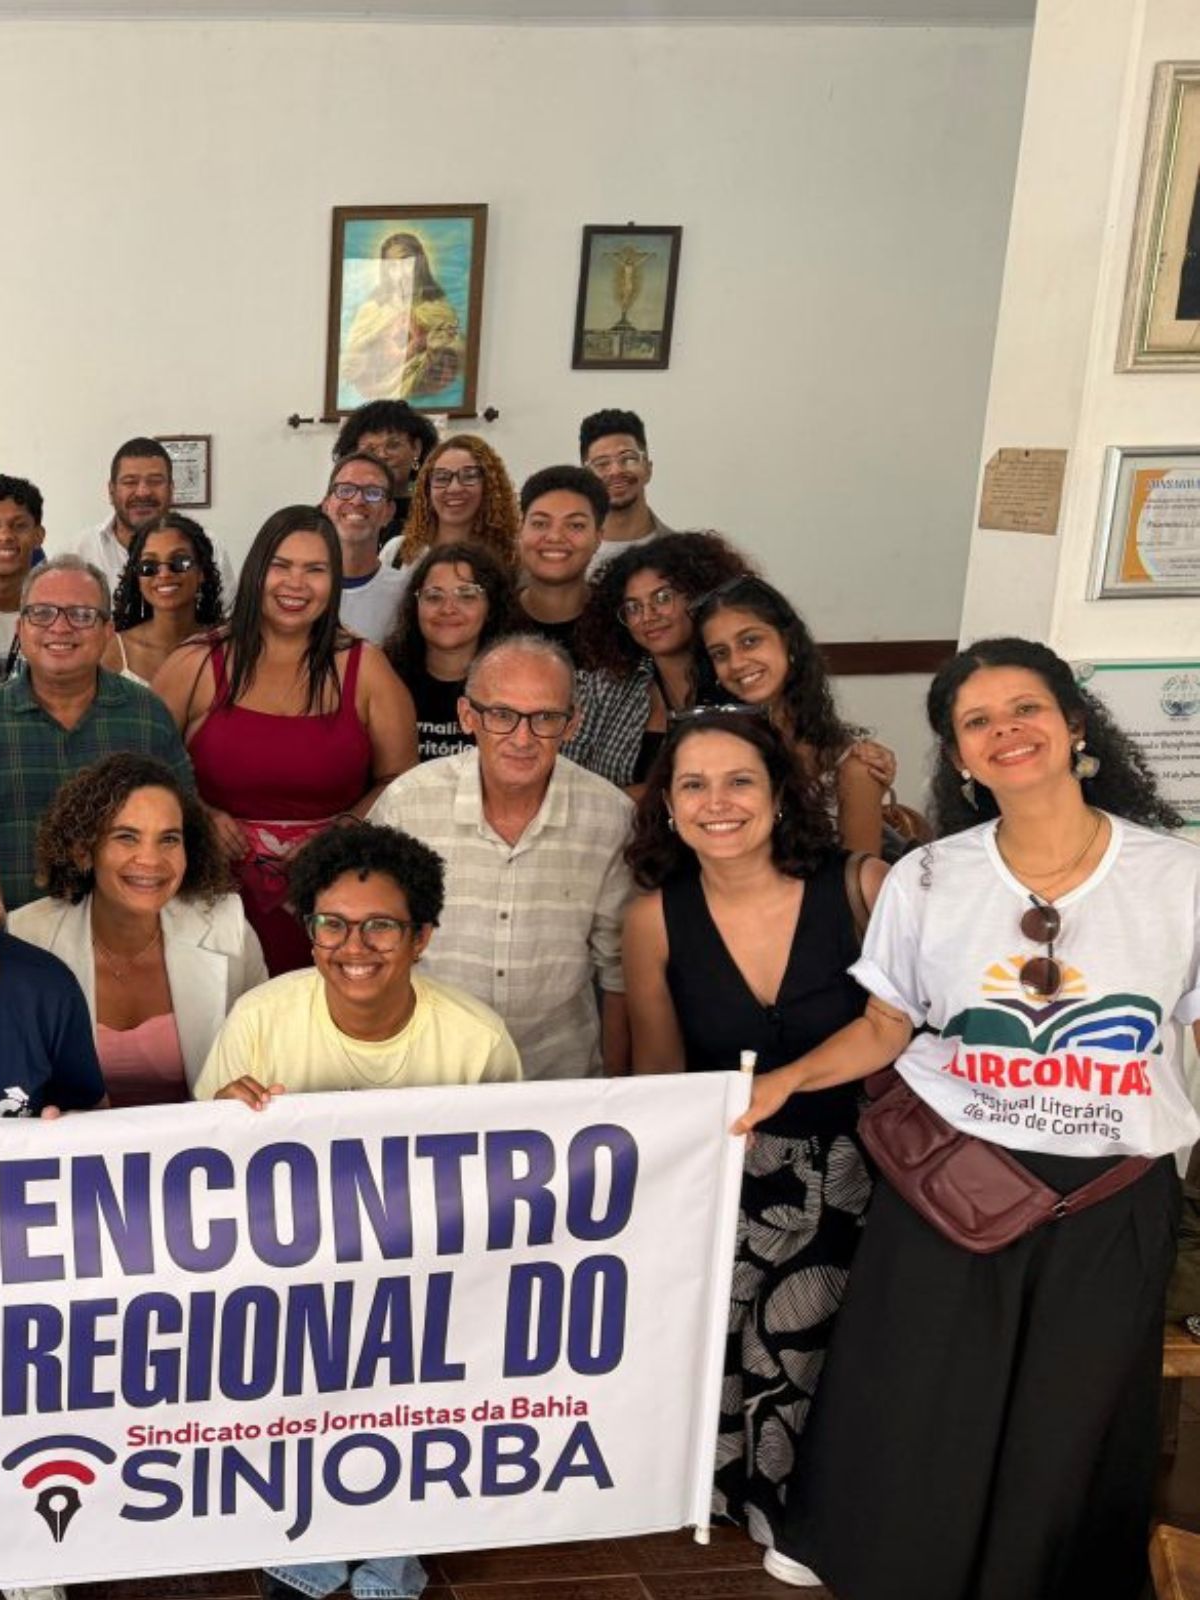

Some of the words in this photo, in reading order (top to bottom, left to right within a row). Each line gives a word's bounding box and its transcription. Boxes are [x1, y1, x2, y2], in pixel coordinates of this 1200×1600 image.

[416, 721, 462, 735] rnali
[942, 1053, 1153, 1096] LIRCONTA
[1025, 1112, 1047, 1132] de
[1052, 1119, 1121, 1141] Contas
[1041, 1097, 1123, 1122] Literário
[2, 1271, 466, 1416] REGIONAL
[502, 1254, 628, 1379] DO
[127, 1420, 261, 1447] Sindicato
[266, 1415, 316, 1437] dos
[321, 1405, 466, 1434] Jornalistas
[472, 1400, 505, 1422] da
[510, 1395, 589, 1419] Bahia
[118, 1420, 615, 1542] SINJORBA
